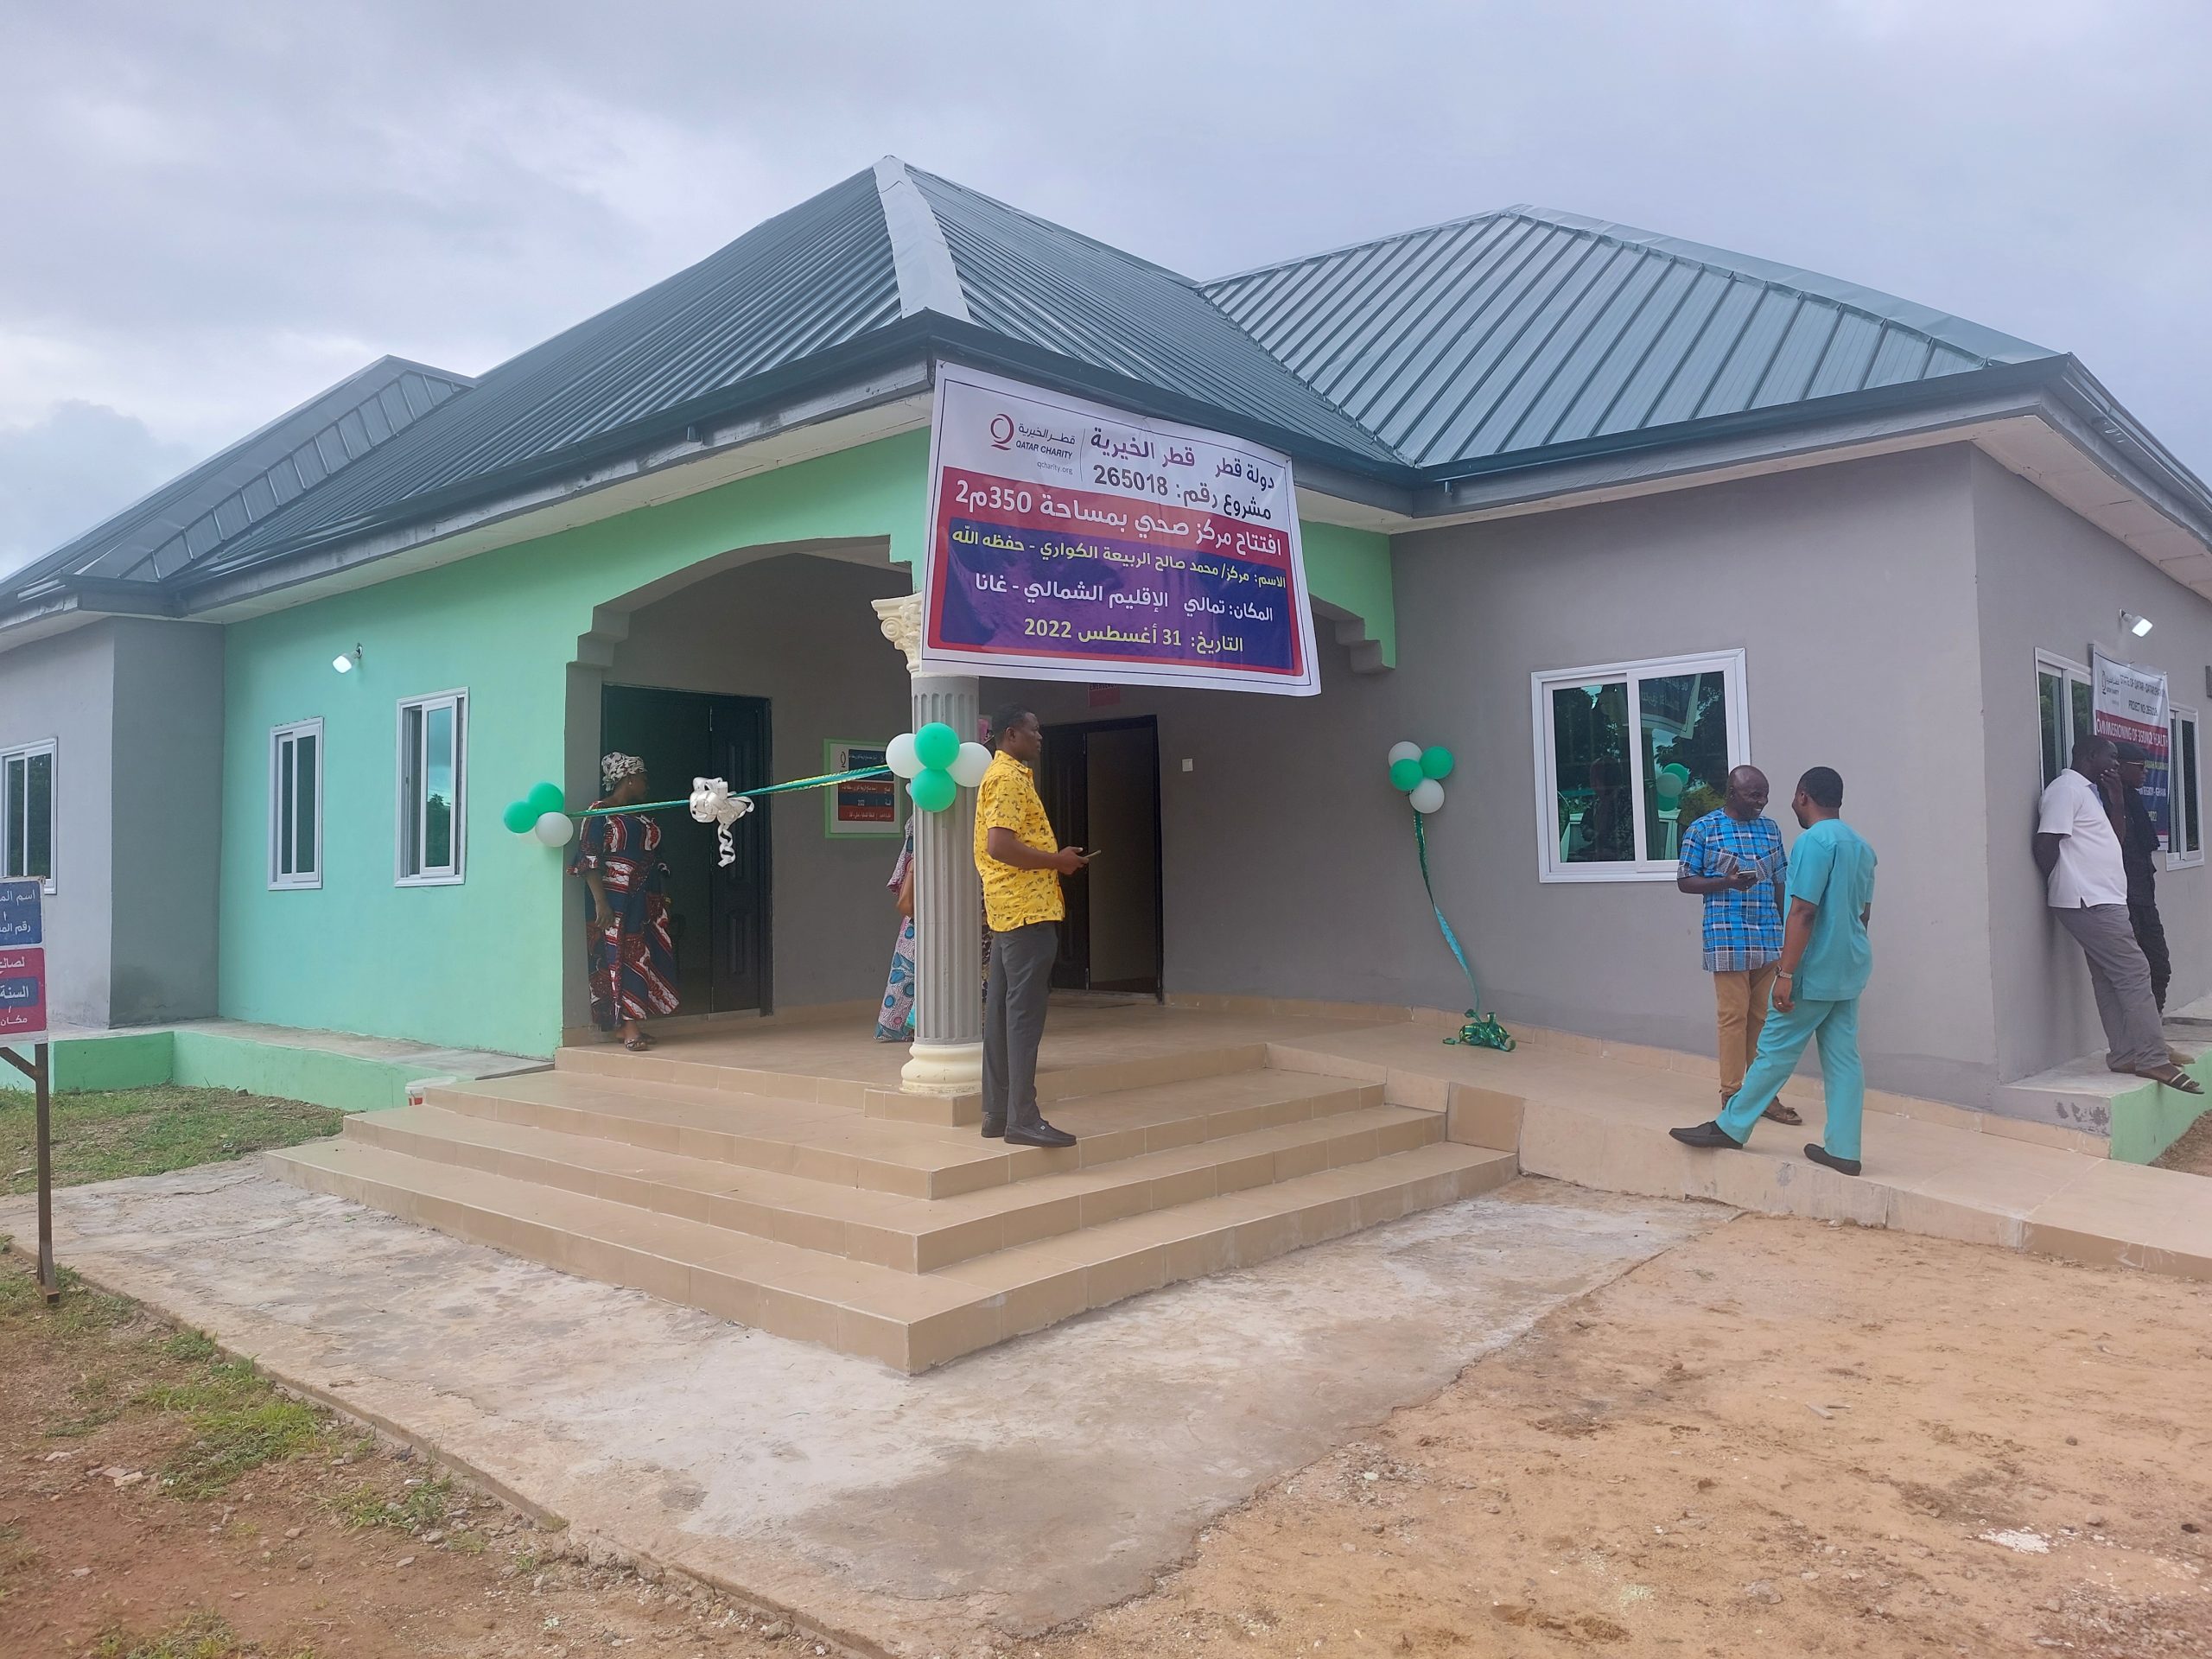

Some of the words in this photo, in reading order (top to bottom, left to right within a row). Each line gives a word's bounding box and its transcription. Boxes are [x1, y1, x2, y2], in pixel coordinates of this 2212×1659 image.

[1019, 423, 1048, 439] الخيرية
[1047, 433, 1076, 445] قطر
[1015, 440, 1039, 452] QATAR
[1040, 445, 1073, 460] CHARITY
[1090, 427, 1155, 461] الخيرية
[1162, 447, 1195, 467] قطر
[1215, 457, 1242, 478] قطر
[1037, 461, 1073, 475] qcharity.org
[1247, 463, 1274, 491] دولة
[1093, 464, 1168, 496] 265018
[1176, 482, 1218, 509] رقم:
[1039, 493, 1128, 533] بمساحة
[1224, 493, 1272, 520] مشروع
[951, 524, 979, 545] الله
[1135, 514, 1190, 539] صحي
[1196, 518, 1232, 549] مركز
[982, 534, 1025, 551] حفظه
[1039, 542, 1098, 561] الكواري
[1236, 531, 1281, 556] افتتاح
[1103, 546, 1151, 569] الربيعة
[1154, 555, 1185, 572] صالح
[1189, 562, 1218, 576] محمد
[976, 572, 1007, 593] غانا
[1254, 573, 1287, 588] الاسم:
[1024, 581, 1103, 603] الشمالي
[1109, 587, 1168, 613] الإقليم
[1184, 596, 1225, 617] تمالي
[1229, 601, 1274, 622] المكان:
[1024, 618, 1072, 639] 2022
[1077, 623, 1158, 643] أغسطس
[1162, 628, 1182, 646] 31
[1191, 630, 1244, 654] التاريخ:
[0, 890, 13, 902] الم
[16, 889, 35, 906] اسم
[0, 923, 12, 933] الم
[15, 920, 31, 935] رقم
[0, 984, 29, 999] السنة
[0, 1014, 28, 1027] مكان
